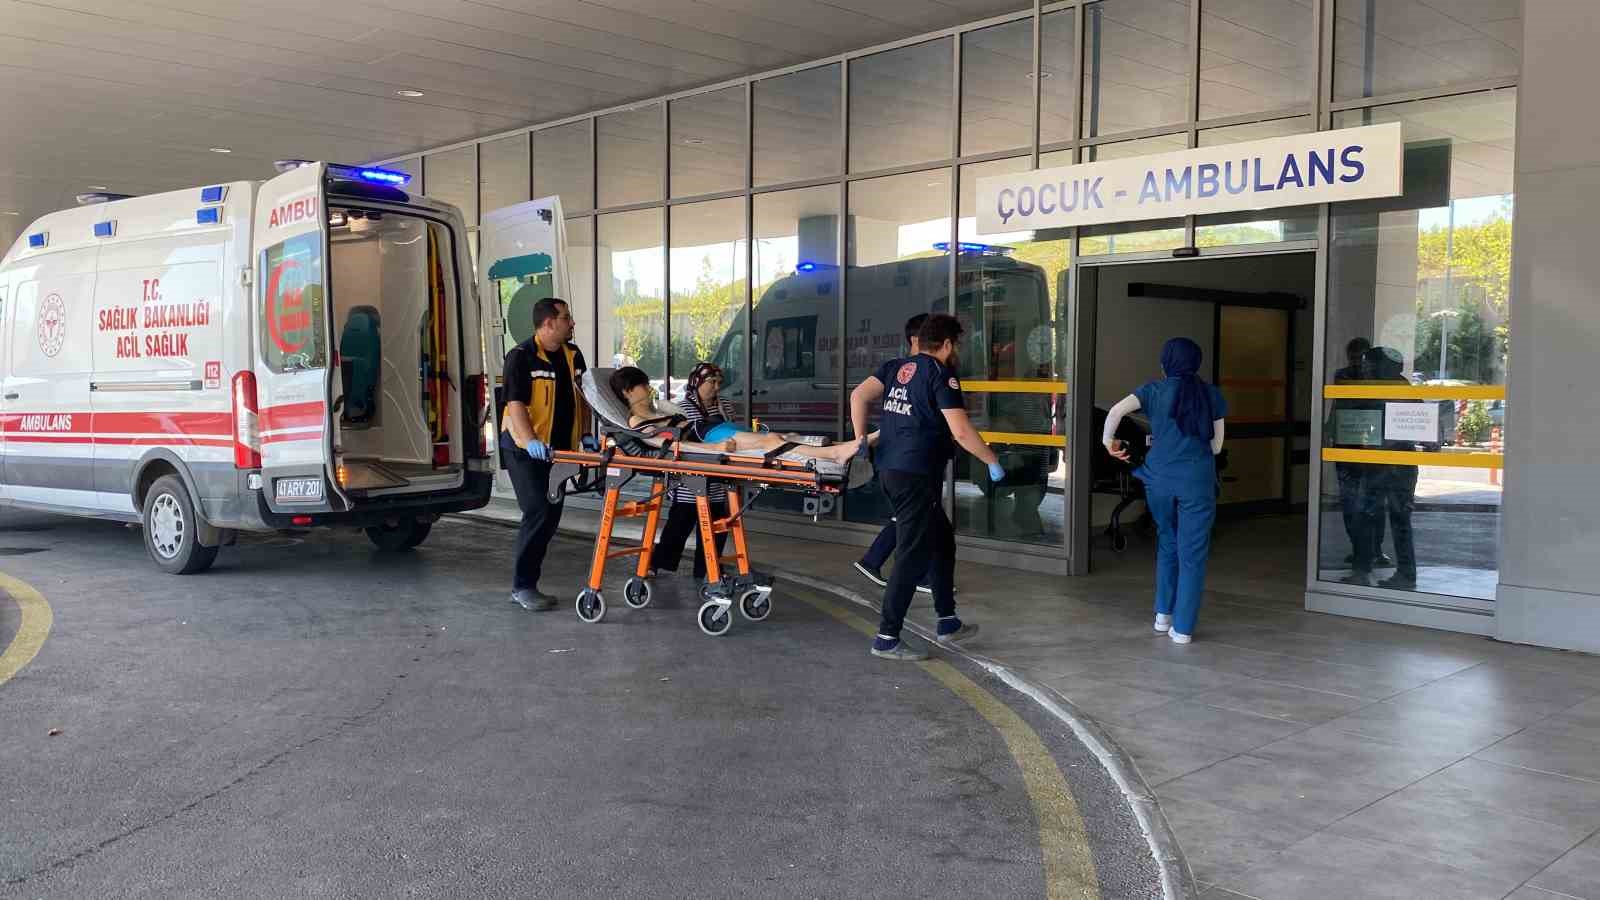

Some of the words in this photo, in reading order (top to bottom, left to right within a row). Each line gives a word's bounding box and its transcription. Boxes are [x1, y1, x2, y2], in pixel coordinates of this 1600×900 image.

[996, 176, 1104, 225] ÇOCUK
[1113, 189, 1128, 198] -
[1137, 145, 1365, 205] AMBULANS
[143, 279, 162, 302] T.C.
[98, 305, 138, 331] SAĞLIK
[144, 299, 209, 329] BAKANLIĞI
[116, 332, 141, 358] ACİL
[145, 331, 188, 357] SAĞLIK
[888, 386, 908, 401] ACİL
[20, 414, 72, 431] AMBULANS
[305, 480, 320, 496] 201
